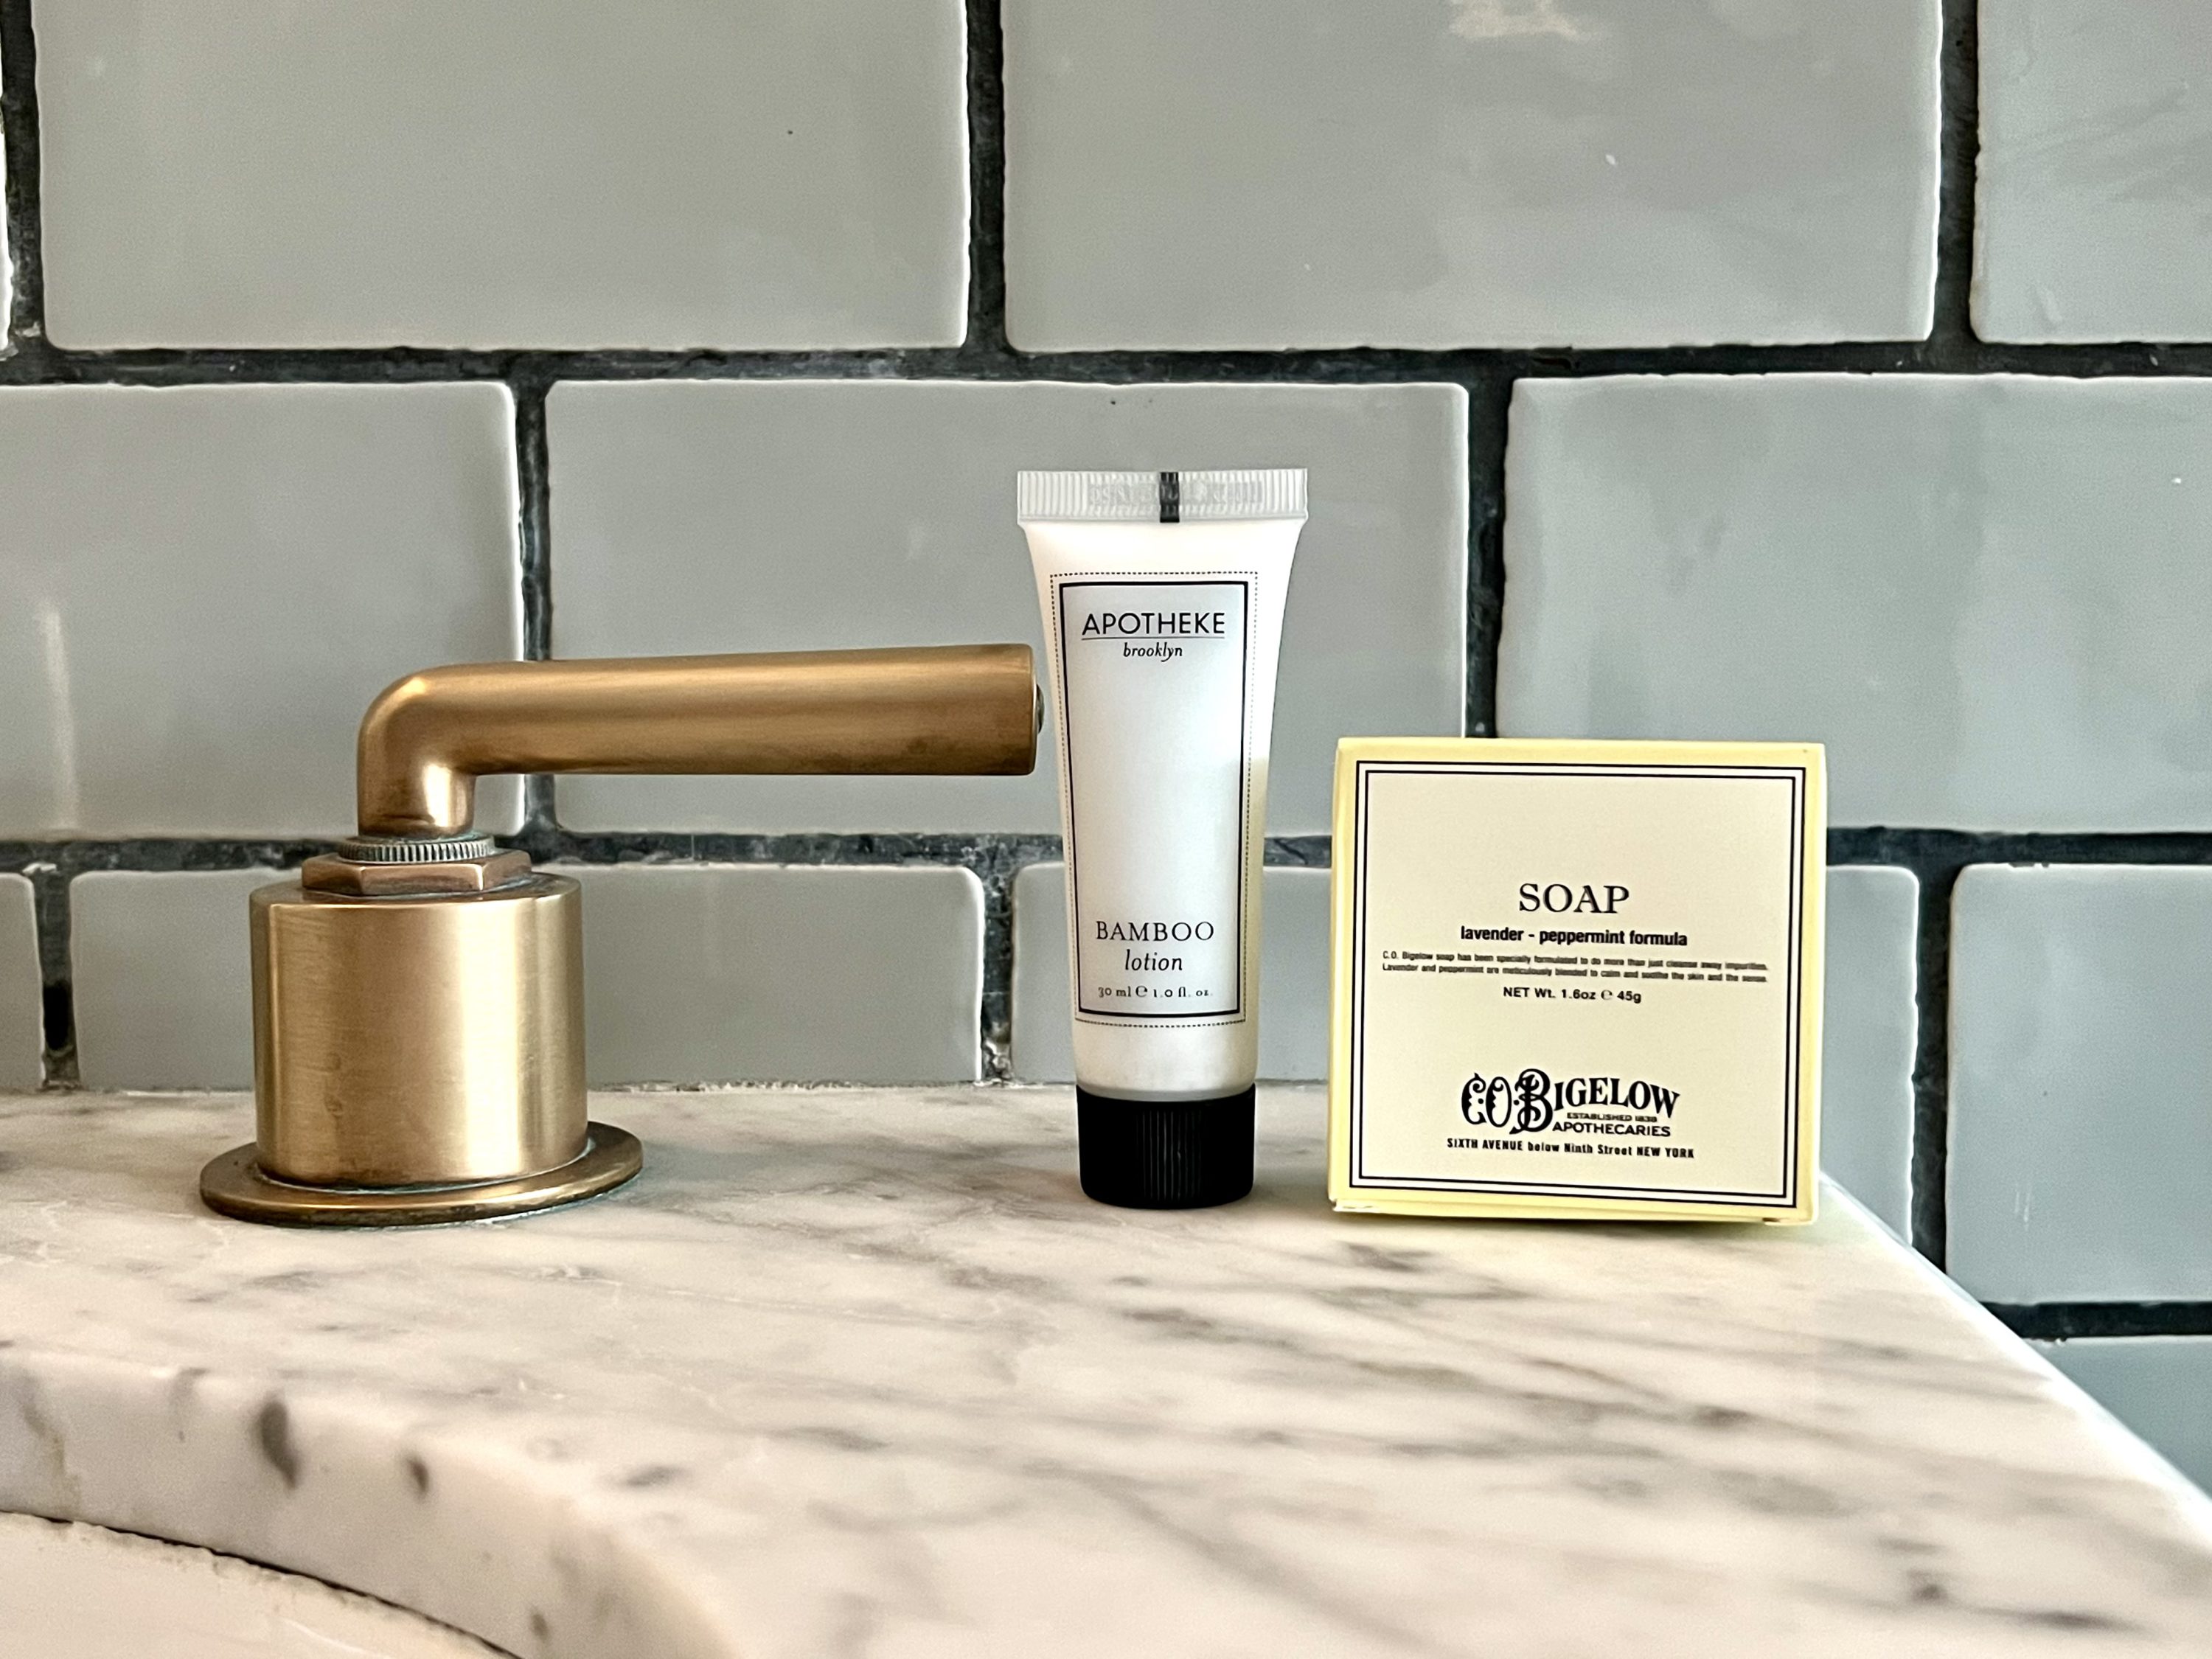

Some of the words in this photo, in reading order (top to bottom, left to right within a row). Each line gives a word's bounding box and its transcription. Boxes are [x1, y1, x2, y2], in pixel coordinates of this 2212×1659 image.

[1082, 612, 1225, 636] APOTHEKE
[1123, 641, 1183, 662] brooklyn
[1519, 883, 1630, 914] SOAP
[1096, 920, 1214, 942] BAMBOO
[1461, 925, 1524, 942] lavender
[1539, 929, 1626, 947] peppermint
[1630, 930, 1688, 947] formula
[1124, 948, 1183, 971] lotion
[1382, 950, 1399, 959] C.O.
[1098, 987, 1113, 998] 30
[1116, 985, 1132, 998] ml
[1153, 989, 1174, 998] 1.0
[1178, 986, 1192, 998] fl.
[1503, 986, 1530, 998] NET
[1562, 988, 1596, 1001] 1.6oz
[1616, 990, 1642, 1004] 45g
[1567, 1112, 1632, 1121] ESTABLISHED
[1552, 1121, 1672, 1137] APOTHECARIES
[1447, 1138, 1478, 1149] SIXTH
[1482, 1139, 1523, 1151] AVENUE
[1528, 1141, 1560, 1152] below
[1564, 1143, 1593, 1153] Ninth
[1598, 1144, 1632, 1155] Street
[1636, 1147, 1661, 1157] NEW
[1665, 1147, 1694, 1158] YORK
